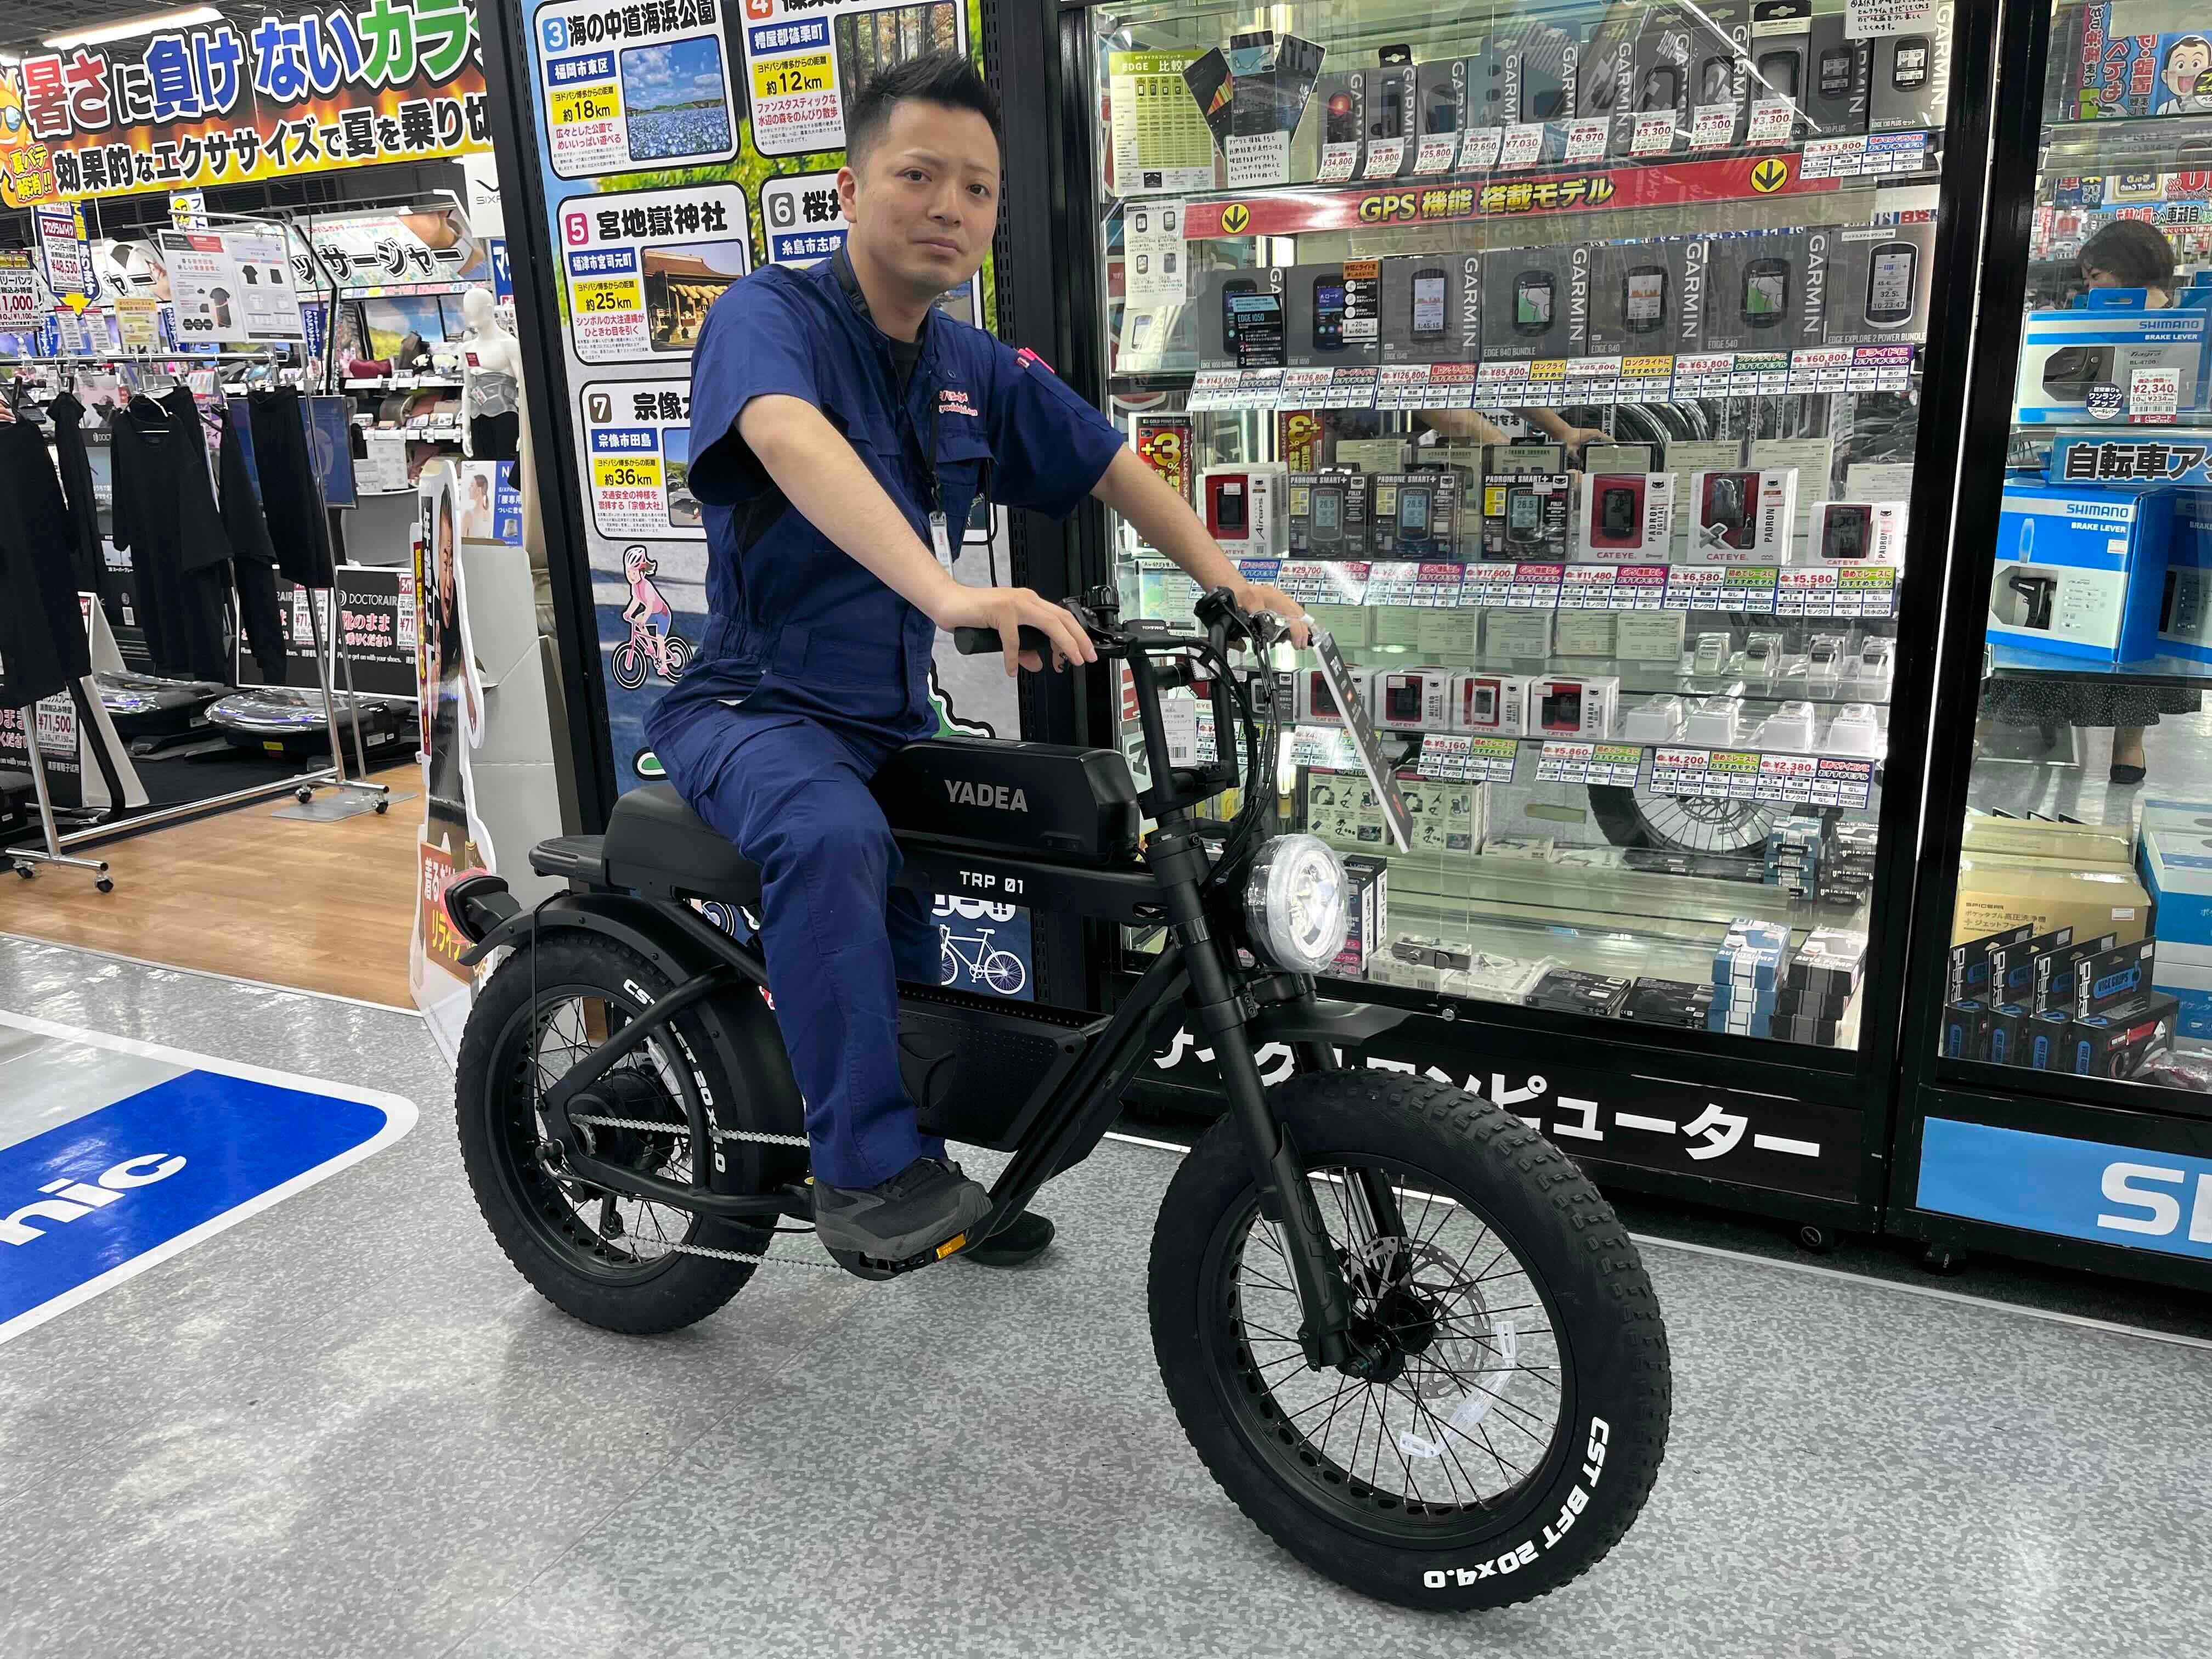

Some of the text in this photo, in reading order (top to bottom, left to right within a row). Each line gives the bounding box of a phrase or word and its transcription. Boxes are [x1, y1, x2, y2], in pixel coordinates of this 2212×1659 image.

[548, 0, 716, 47] 3 海の中道海浜公園
[1931, 4, 1954, 106] GARMIN
[23, 0, 483, 138] 暑さに負けないカラ
[554, 57, 610, 80] 福岡市東区
[758, 54, 827, 74] ヨドバシ博多からの距離
[1122, 62, 1149, 72] EDGE
[766, 71, 822, 95] 約12km
[1562, 46, 1576, 132] GARMIN
[1617, 42, 1632, 127] GARMIN
[555, 85, 614, 102] ヨドバシ博多からの距離
[563, 100, 611, 122] 約18km
[1402, 67, 1414, 149] GARMIN
[758, 106, 838, 127] 水辺の森をのんびり散歩
[1753, 114, 1790, 125] ¥3,300
[556, 122, 613, 139] 広々とした公園で
[1636, 126, 1671, 137] ¥3,300
[1695, 120, 1730, 131] ¥3,300
[1571, 133, 1604, 142] ¥6,970
[1820, 142, 1861, 152] ¥33,800
[1420, 149, 1451, 158] ¥25,800
[1358, 178, 1615, 223] GPS 機能 搭載モデル
[774, 196, 789, 223] 6
[570, 200, 728, 242] 5 宮地嶽神社
[572, 253, 633, 272] 福津市宮司元町
[579, 281, 635, 292] ヨドバシ博多からの距離
[1803, 234, 1826, 333] GARMIN
[1570, 248, 1587, 341] GARMIN
[1682, 242, 1702, 338] GARMIN
[586, 292, 633, 312] 約25km
[1462, 257, 1479, 348] GARMIN
[576, 313, 645, 326] シンボルの大注連縄が
[1237, 314, 1251, 323] EDGE
[2139, 320, 2199, 329] SHIMANO
[584, 325, 639, 338] ひときわ目を引く
[1844, 335, 1872, 343] EXPLORE
[1878, 334, 1900, 342] POWER
[1900, 332, 1927, 341] BUNDLE
[1483, 348, 1499, 357] EDGE
[1510, 347, 1536, 356] BUNDLE
[1807, 353, 1848, 363] ¥60,800
[1624, 358, 1669, 366] ロングライドに
[1690, 359, 1729, 369] ¥63,800
[1855, 357, 1909, 365] おすすめモデル
[1491, 368, 1525, 377] ¥85,800
[2133, 384, 2174, 393] ¥2,340
[592, 397, 607, 420] 7
[599, 432, 652, 448] 宗像市田島
[2063, 441, 2212, 482] 自転車ア
[605, 469, 652, 486] 約36km
[1319, 476, 1347, 484] SMART+
[1377, 475, 1437, 484] PADRONE SMART+
[1485, 475, 1549, 483] PADRONE SMART+
[2067, 504, 2129, 518] SHIMANO
[2071, 522, 2126, 533] BRAKE LEVER
[1684, 573, 1720, 582] ¥6,580
[1728, 569, 1774, 577] 初めてレースに
[1793, 574, 1833, 584] ¥5,580
[1842, 569, 1892, 580] 初めてレースに
[1726, 577, 1774, 585] おすすめモデル
[1840, 579, 1892, 588] おすすめモデル
[349, 593, 397, 606] DOCTORAIR
[38, 713, 71, 733] ¥71,500
[1434, 741, 1466, 749] ¥5,160
[1554, 747, 1589, 756] ¥5,860
[1713, 752, 1757, 763] 初めてレースに
[1668, 755, 1704, 764] ¥4,200
[1711, 763, 1757, 771] おすすめモデル
[1773, 762, 1812, 772] ¥2,380
[1818, 770, 1869, 780] おすすめモデル
[944, 779, 1029, 812] YADEA
[960, 870, 1024, 894] TRP 01
[1582, 1417, 1610, 1488] CST
[1542, 1484, 1590, 1549] BFT
